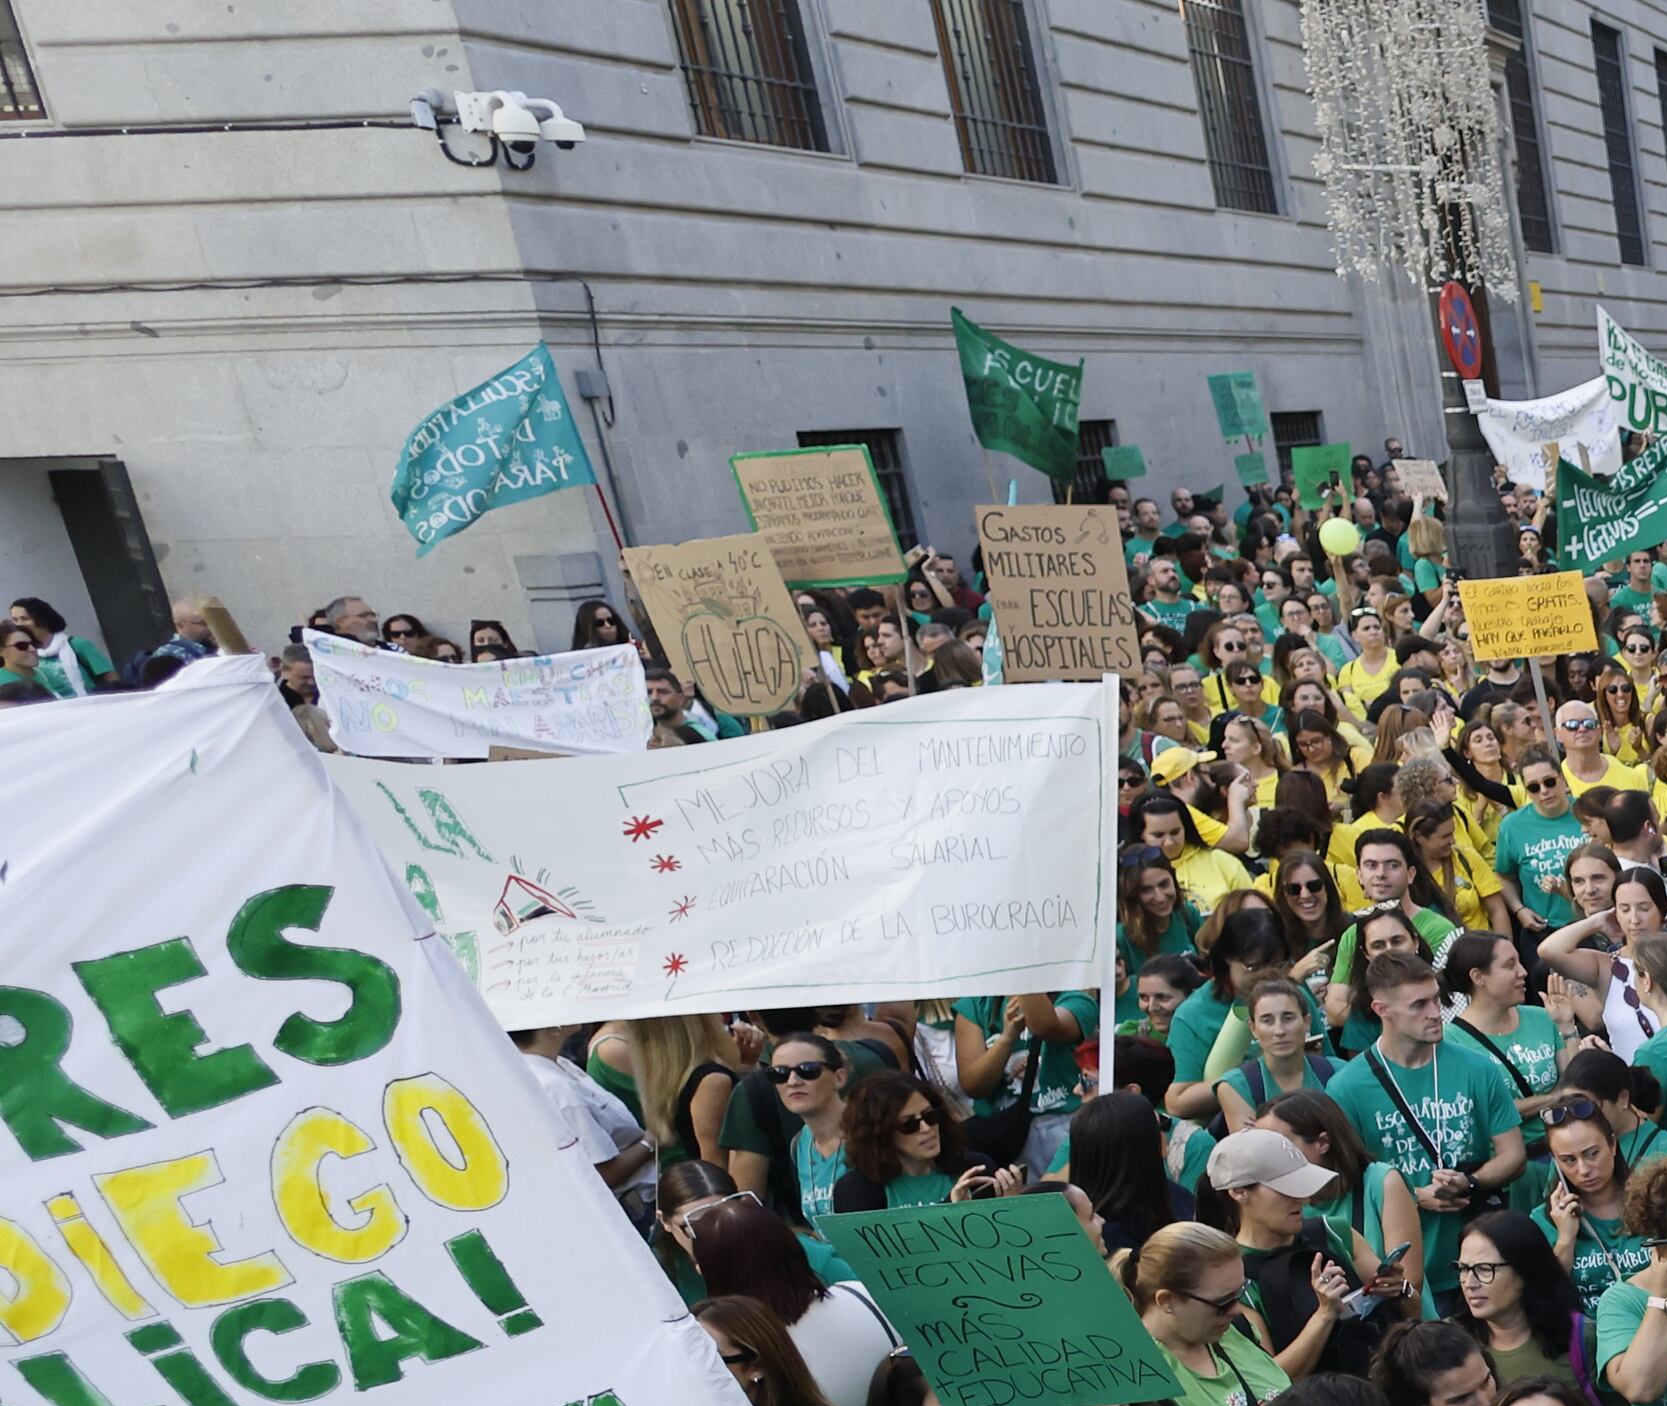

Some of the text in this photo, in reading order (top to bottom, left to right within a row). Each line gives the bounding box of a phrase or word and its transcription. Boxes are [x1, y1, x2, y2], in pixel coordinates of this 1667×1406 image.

[982, 512, 1067, 543] GASTOS
[653, 563, 675, 580] EN
[988, 552, 1097, 579] MILITARES
[1030, 588, 1134, 628] ESCUELAS
[1003, 636, 1134, 671] HOSPITALES
[1474, 631, 1500, 648] HAY
[1505, 630, 1527, 644] QUE
[685, 623, 797, 706] HUELGA
[339, 696, 399, 733] NO
[674, 732, 1088, 832] MEJORA DEL MANTENIMIENTO
[697, 785, 1022, 866] MÁS RECURSOS APOYOS
[706, 834, 1009, 912] EQUIPARACIÓN SALARIAL
[711, 920, 825, 971] REDUCCIÓN
[840, 918, 863, 945] DE
[881, 911, 913, 941] LA
[853, 1208, 1034, 1260] MENOS
[877, 1250, 1084, 1292] LECTIVAS
[914, 1310, 1025, 1349] MÁS
[937, 1334, 1125, 1379] CALIDAD
